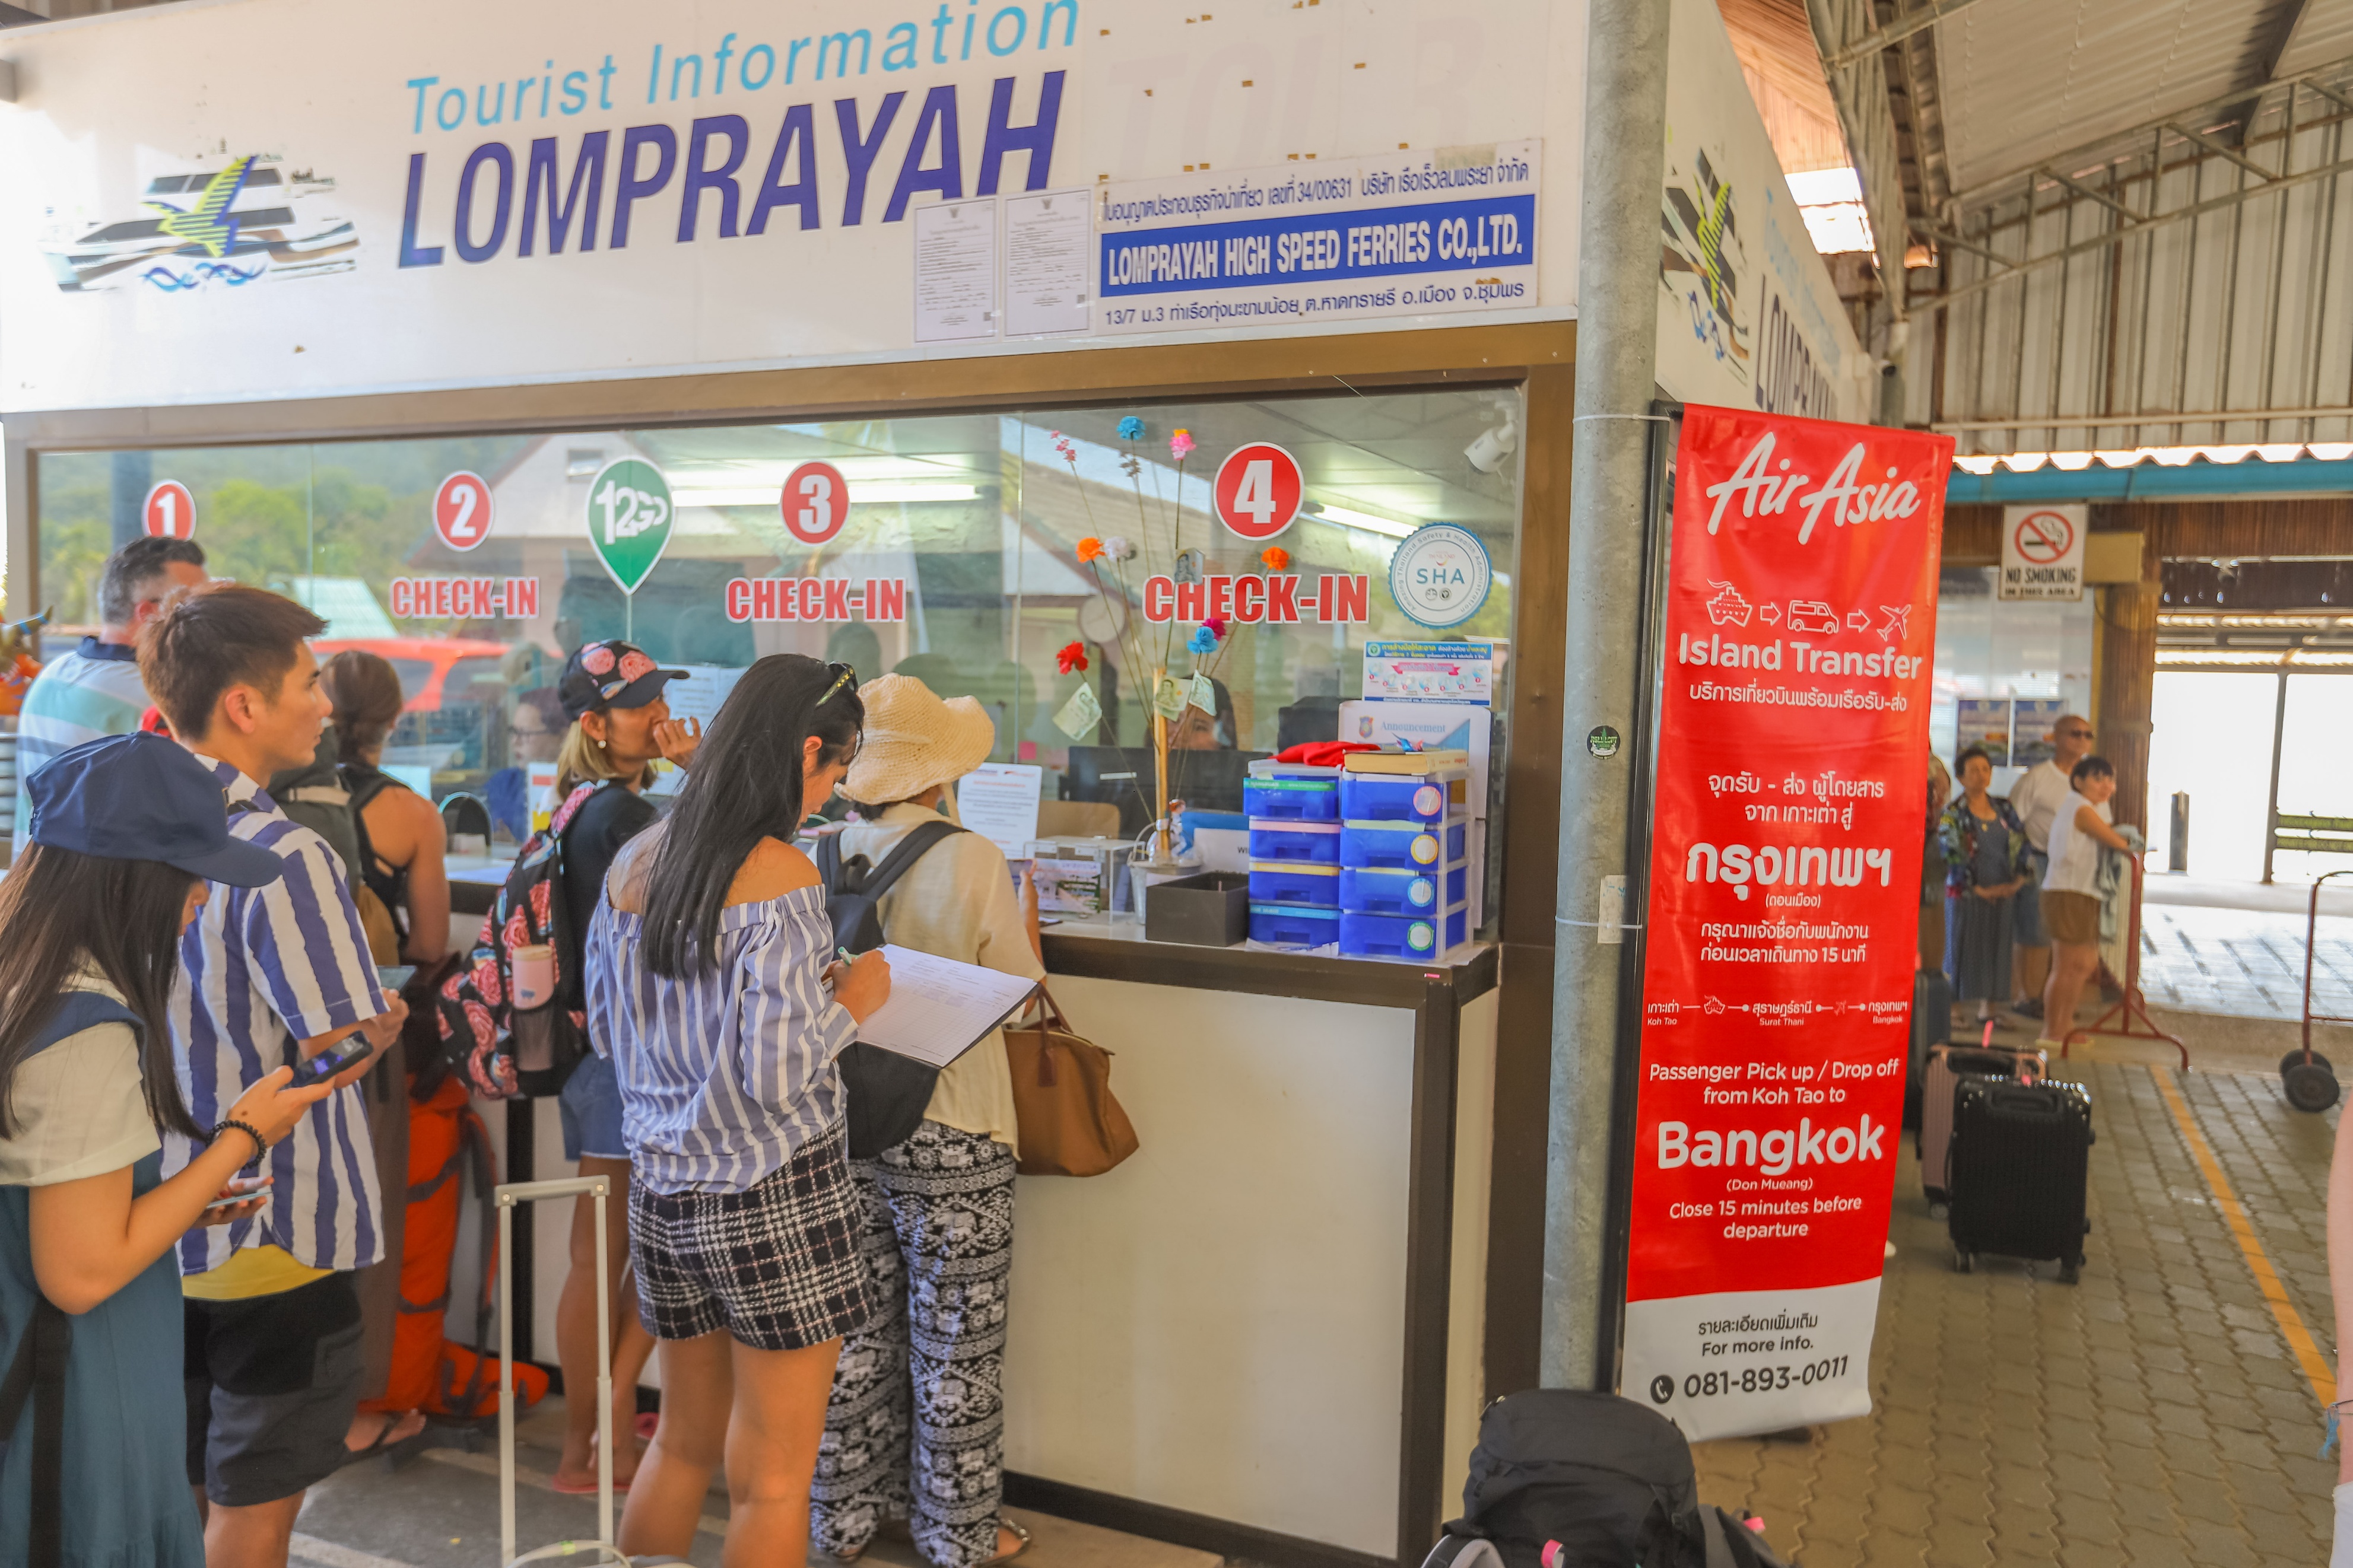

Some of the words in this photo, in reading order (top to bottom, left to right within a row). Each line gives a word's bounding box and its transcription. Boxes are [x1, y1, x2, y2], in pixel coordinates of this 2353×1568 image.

[407, 53, 617, 134] Tourist
[647, 0, 1079, 104] Information
[398, 69, 1067, 269] LOMPRAYAH
[1298, 176, 1352, 202] 34/00631
[1108, 239, 1218, 286] LOMPRAYAH
[1224, 235, 1271, 278] HIGH
[1276, 229, 1341, 273] SPEED
[1347, 220, 1431, 268] FERRIES
[1437, 213, 1523, 265] CO.,LTD.
[1105, 308, 1136, 325] 13/7
[1141, 307, 1164, 323] ม.3
[798, 474, 832, 534] 3
[1233, 459, 1276, 524] 4
[155, 492, 177, 537] 1
[449, 483, 478, 539] 2
[1415, 568, 1465, 585] SHA
[2006, 567, 2020, 582] NO
[2025, 567, 2075, 583] SMOKING
[390, 576, 539, 619] CHECK-IN
[726, 577, 906, 622] CHECK-IN
[1142, 573, 1370, 624] CHECK-IN
[1678, 632, 1781, 671] Island
[1790, 641, 1923, 680] Transfer
[1381, 721, 1446, 733] Announcement
[1745, 803, 1777, 822] จาก
[1783, 802, 1837, 824] เกาะเต่า
[1685, 841, 1892, 901] กรุงเทพฯ
[1822, 946, 1838, 963] 15
[1841, 944, 1866, 963] นาที
[1647, 1017, 1662, 1026] Koh
[1663, 1017, 1678, 1026] Tao
[1760, 1016, 1780, 1026] Surat
[1783, 1016, 1804, 1026] Thani
[1872, 1014, 1904, 1025] Bangkok
[1650, 1063, 1740, 1084] Passenger
[1747, 1062, 1787, 1081] Pick
[1791, 1066, 1814, 1084] up
[1832, 1061, 1872, 1081] Drop
[1876, 1058, 1900, 1076] off
[1704, 1087, 1748, 1105] from
[1752, 1087, 1789, 1105] Koh
[1795, 1087, 1824, 1104] Tao
[1829, 1087, 1846, 1103] to
[1658, 1114, 1884, 1175] Bangkok
[1726, 1179, 1758, 1192] (Don
[1761, 1177, 1814, 1192] Mueang)
[1669, 1202, 1713, 1219] Close
[1719, 1201, 1736, 1216] 15
[1741, 1199, 1808, 1216] minutes
[1813, 1196, 1862, 1213] before
[1723, 1222, 1809, 1241] departure
[1701, 1343, 1728, 1357] For
[1732, 1340, 1774, 1353] more
[1780, 1336, 1814, 1351] info.
[1684, 1354, 1849, 1398] 081-893-0011
